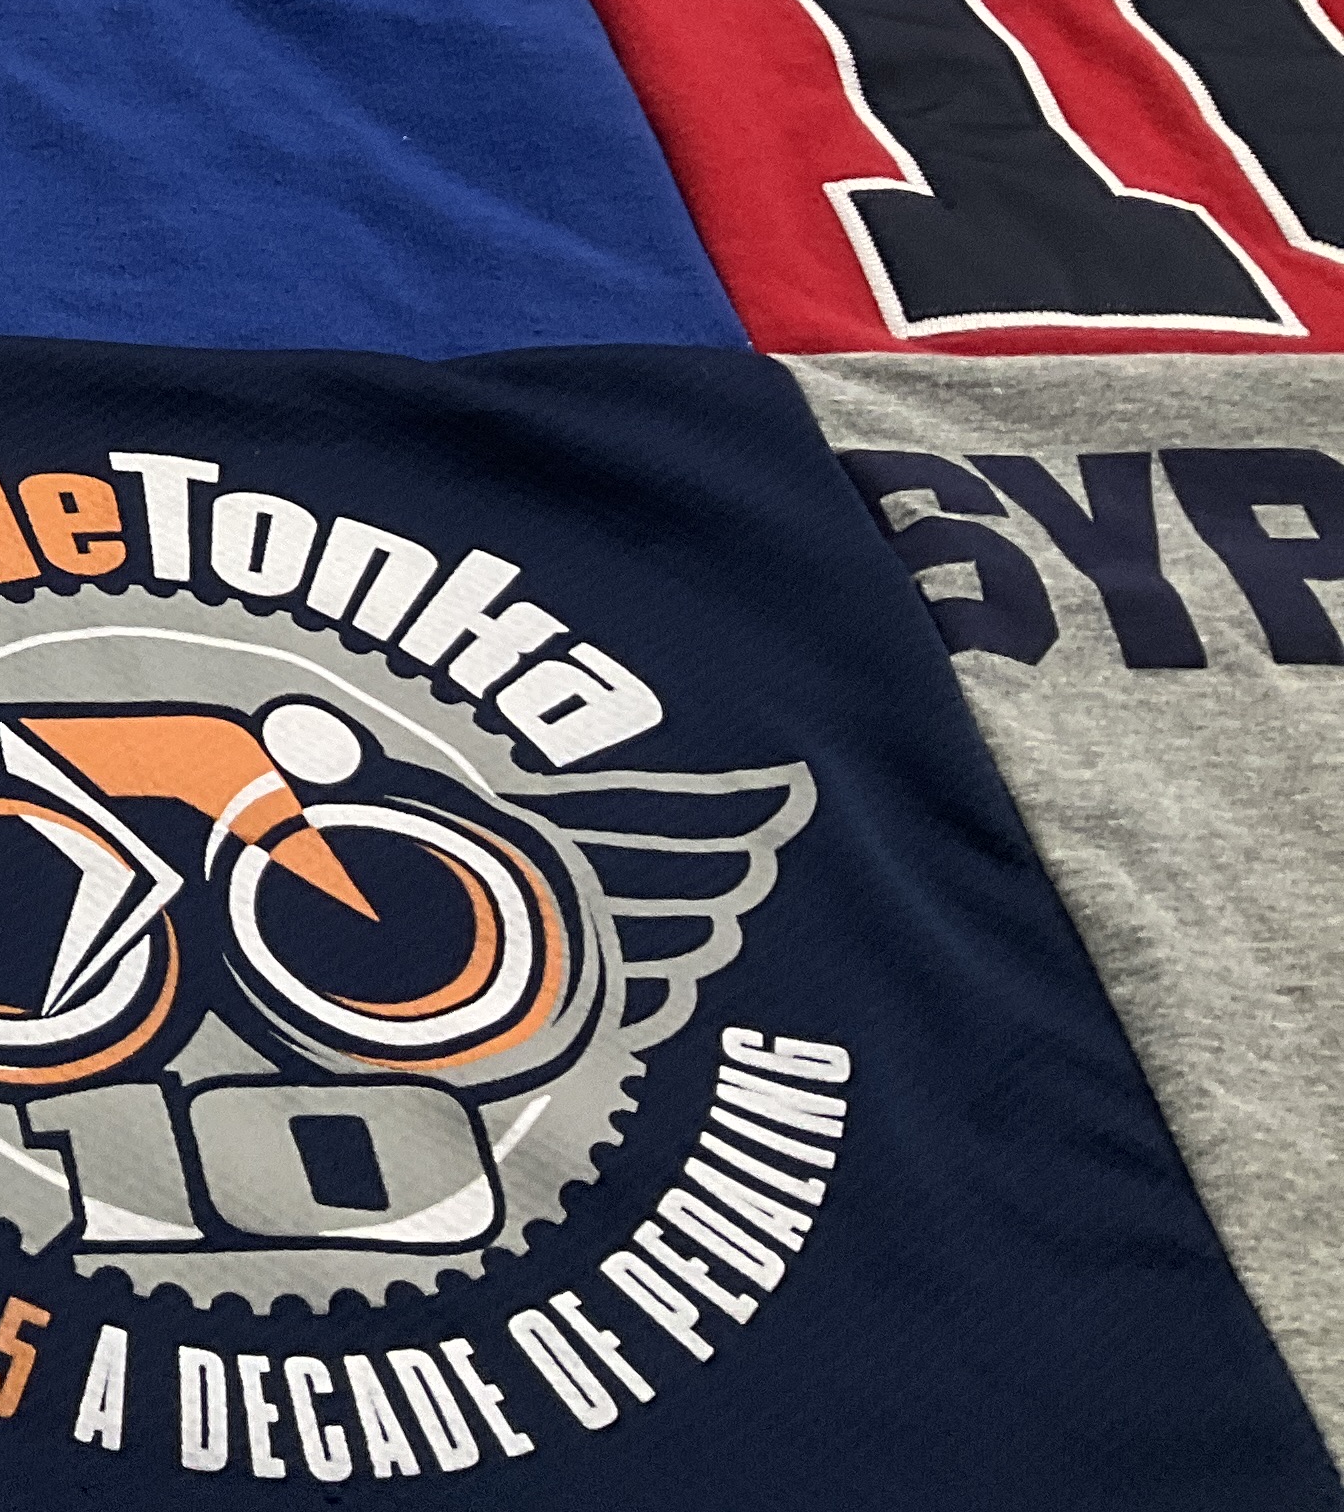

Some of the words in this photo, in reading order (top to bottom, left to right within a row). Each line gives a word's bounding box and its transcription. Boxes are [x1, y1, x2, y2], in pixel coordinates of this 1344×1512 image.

[20, 1080, 503, 1245] 10
[72, 1322, 128, 1452] A
[178, 1334, 536, 1484] DECADE
[507, 1287, 657, 1434] OF
[599, 1023, 853, 1364] PEDALING
